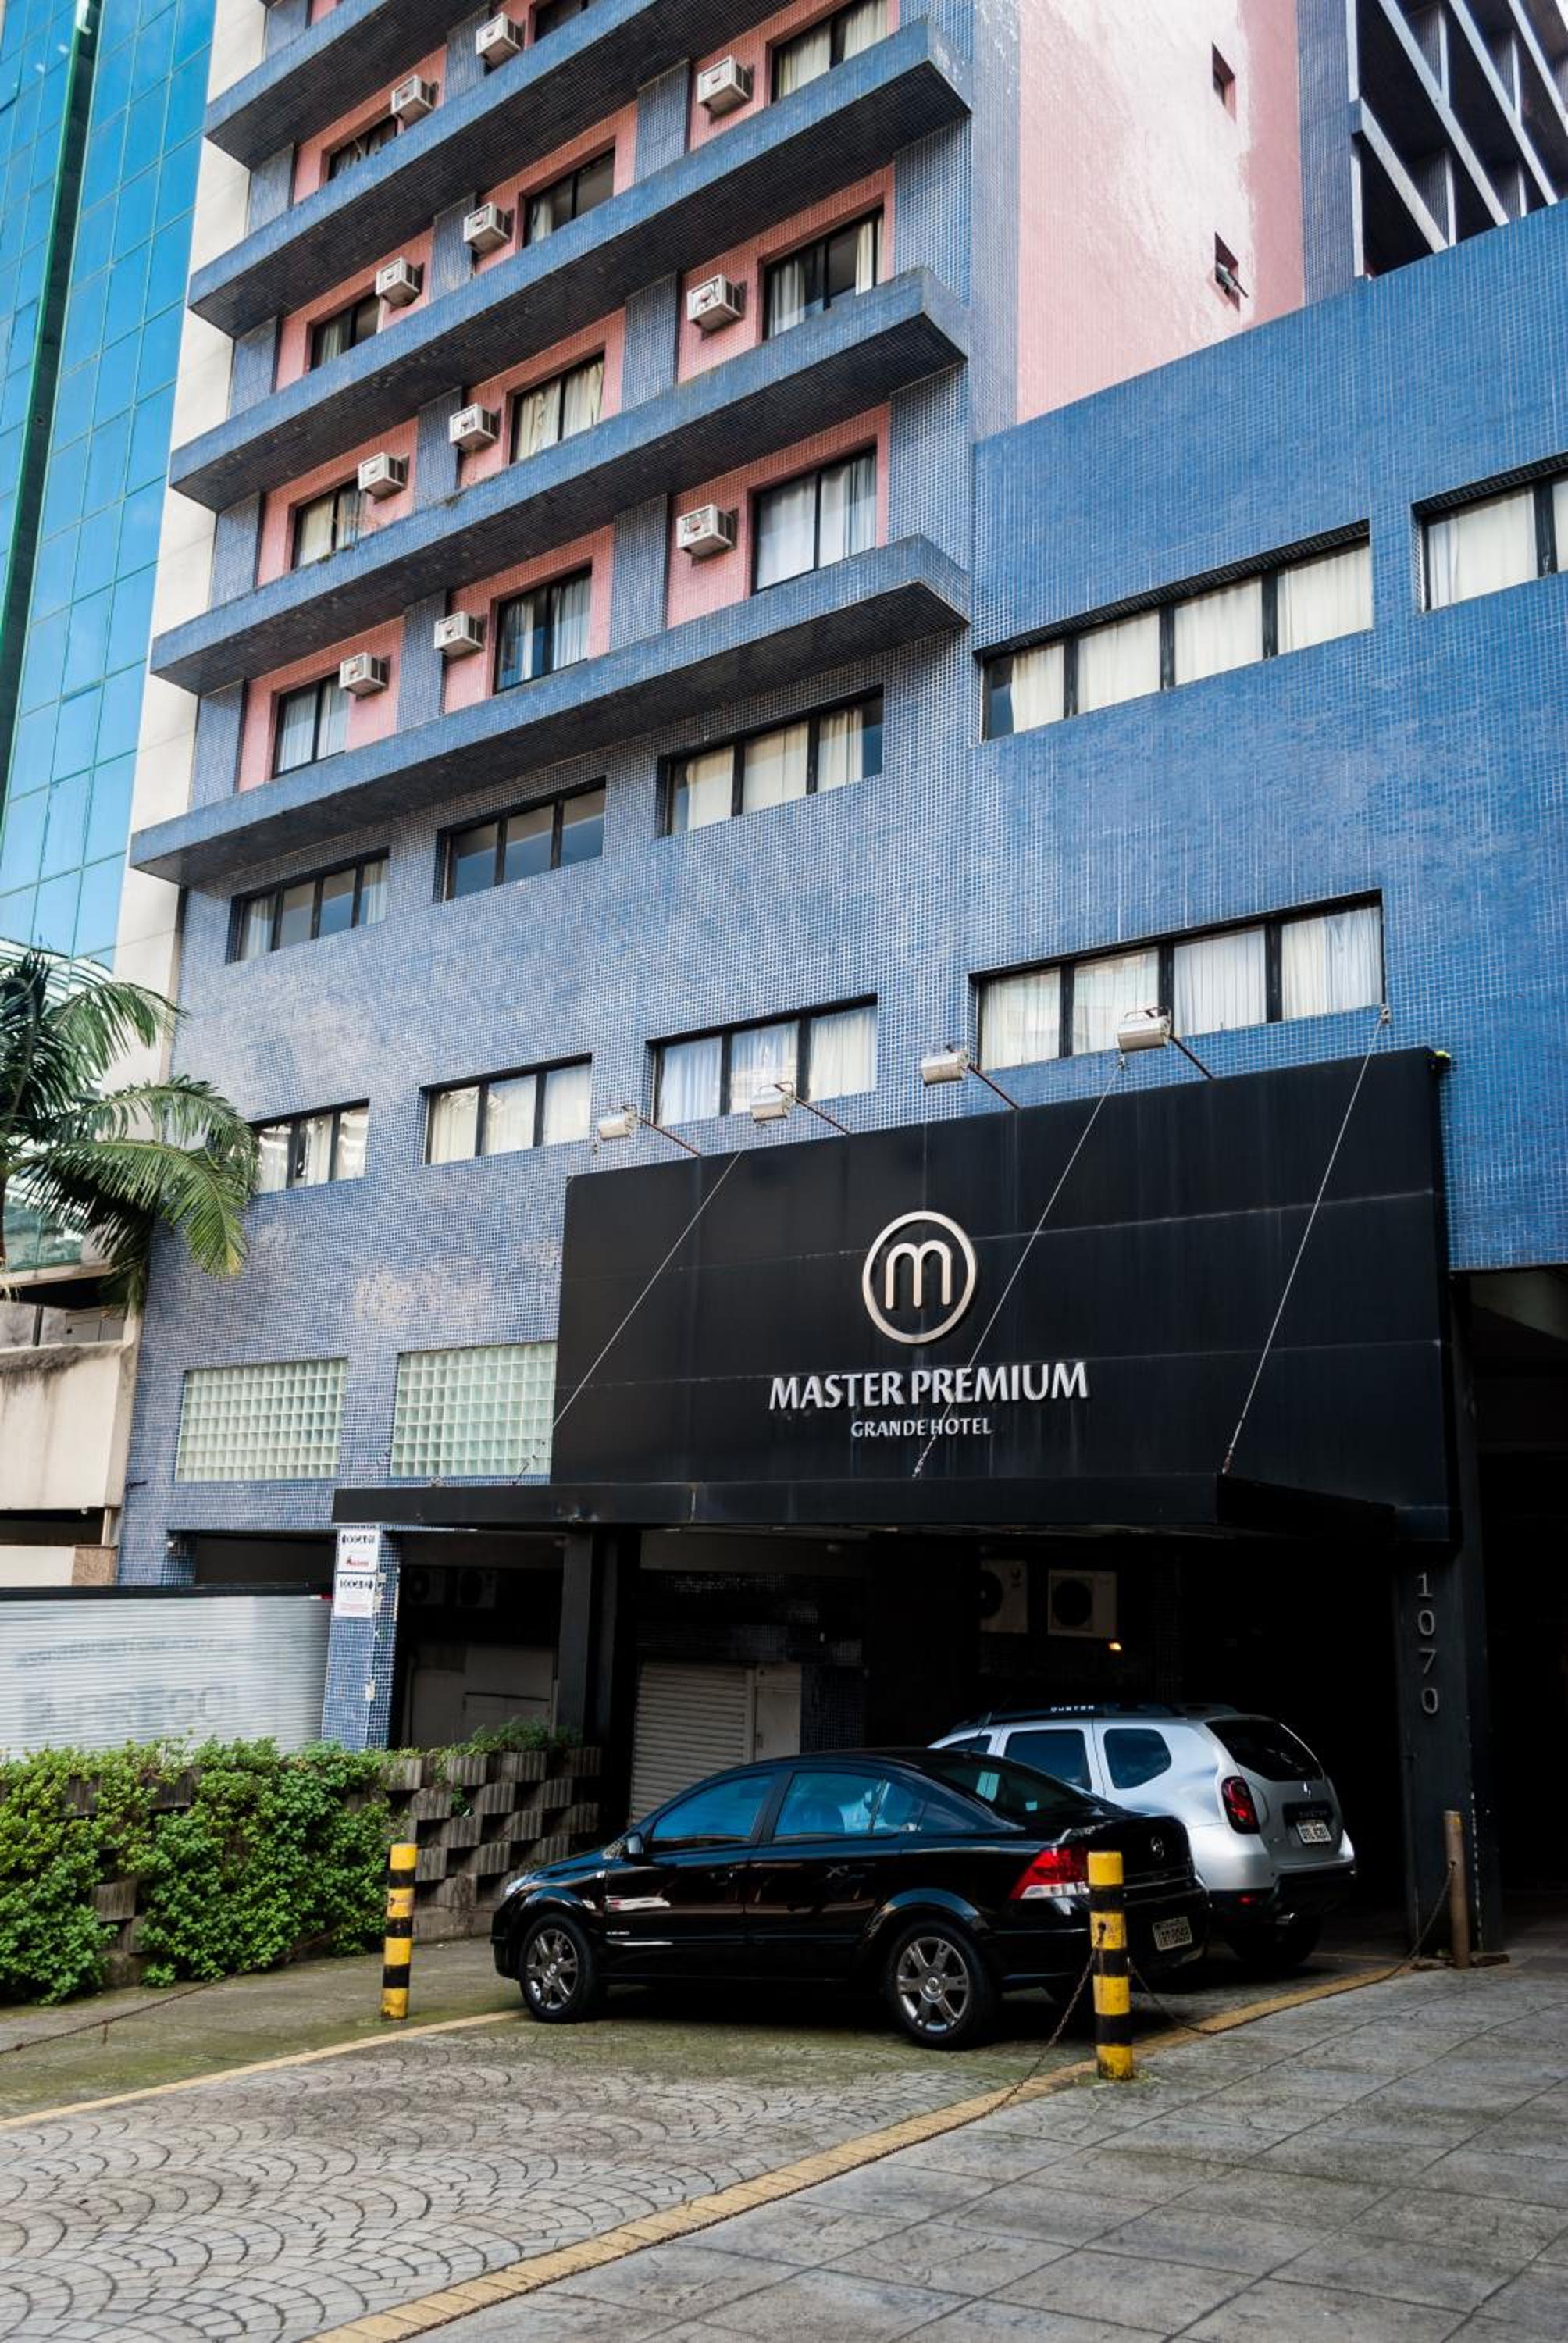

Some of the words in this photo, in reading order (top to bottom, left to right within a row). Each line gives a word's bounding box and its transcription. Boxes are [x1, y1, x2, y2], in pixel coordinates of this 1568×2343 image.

[768, 1371, 906, 1410] MASTER
[911, 1362, 1089, 1405] PREMIUM
[850, 1419, 926, 1438] GRANDE
[930, 1417, 992, 1436] HOTEL
[1417, 1572, 1438, 1714] 1070
